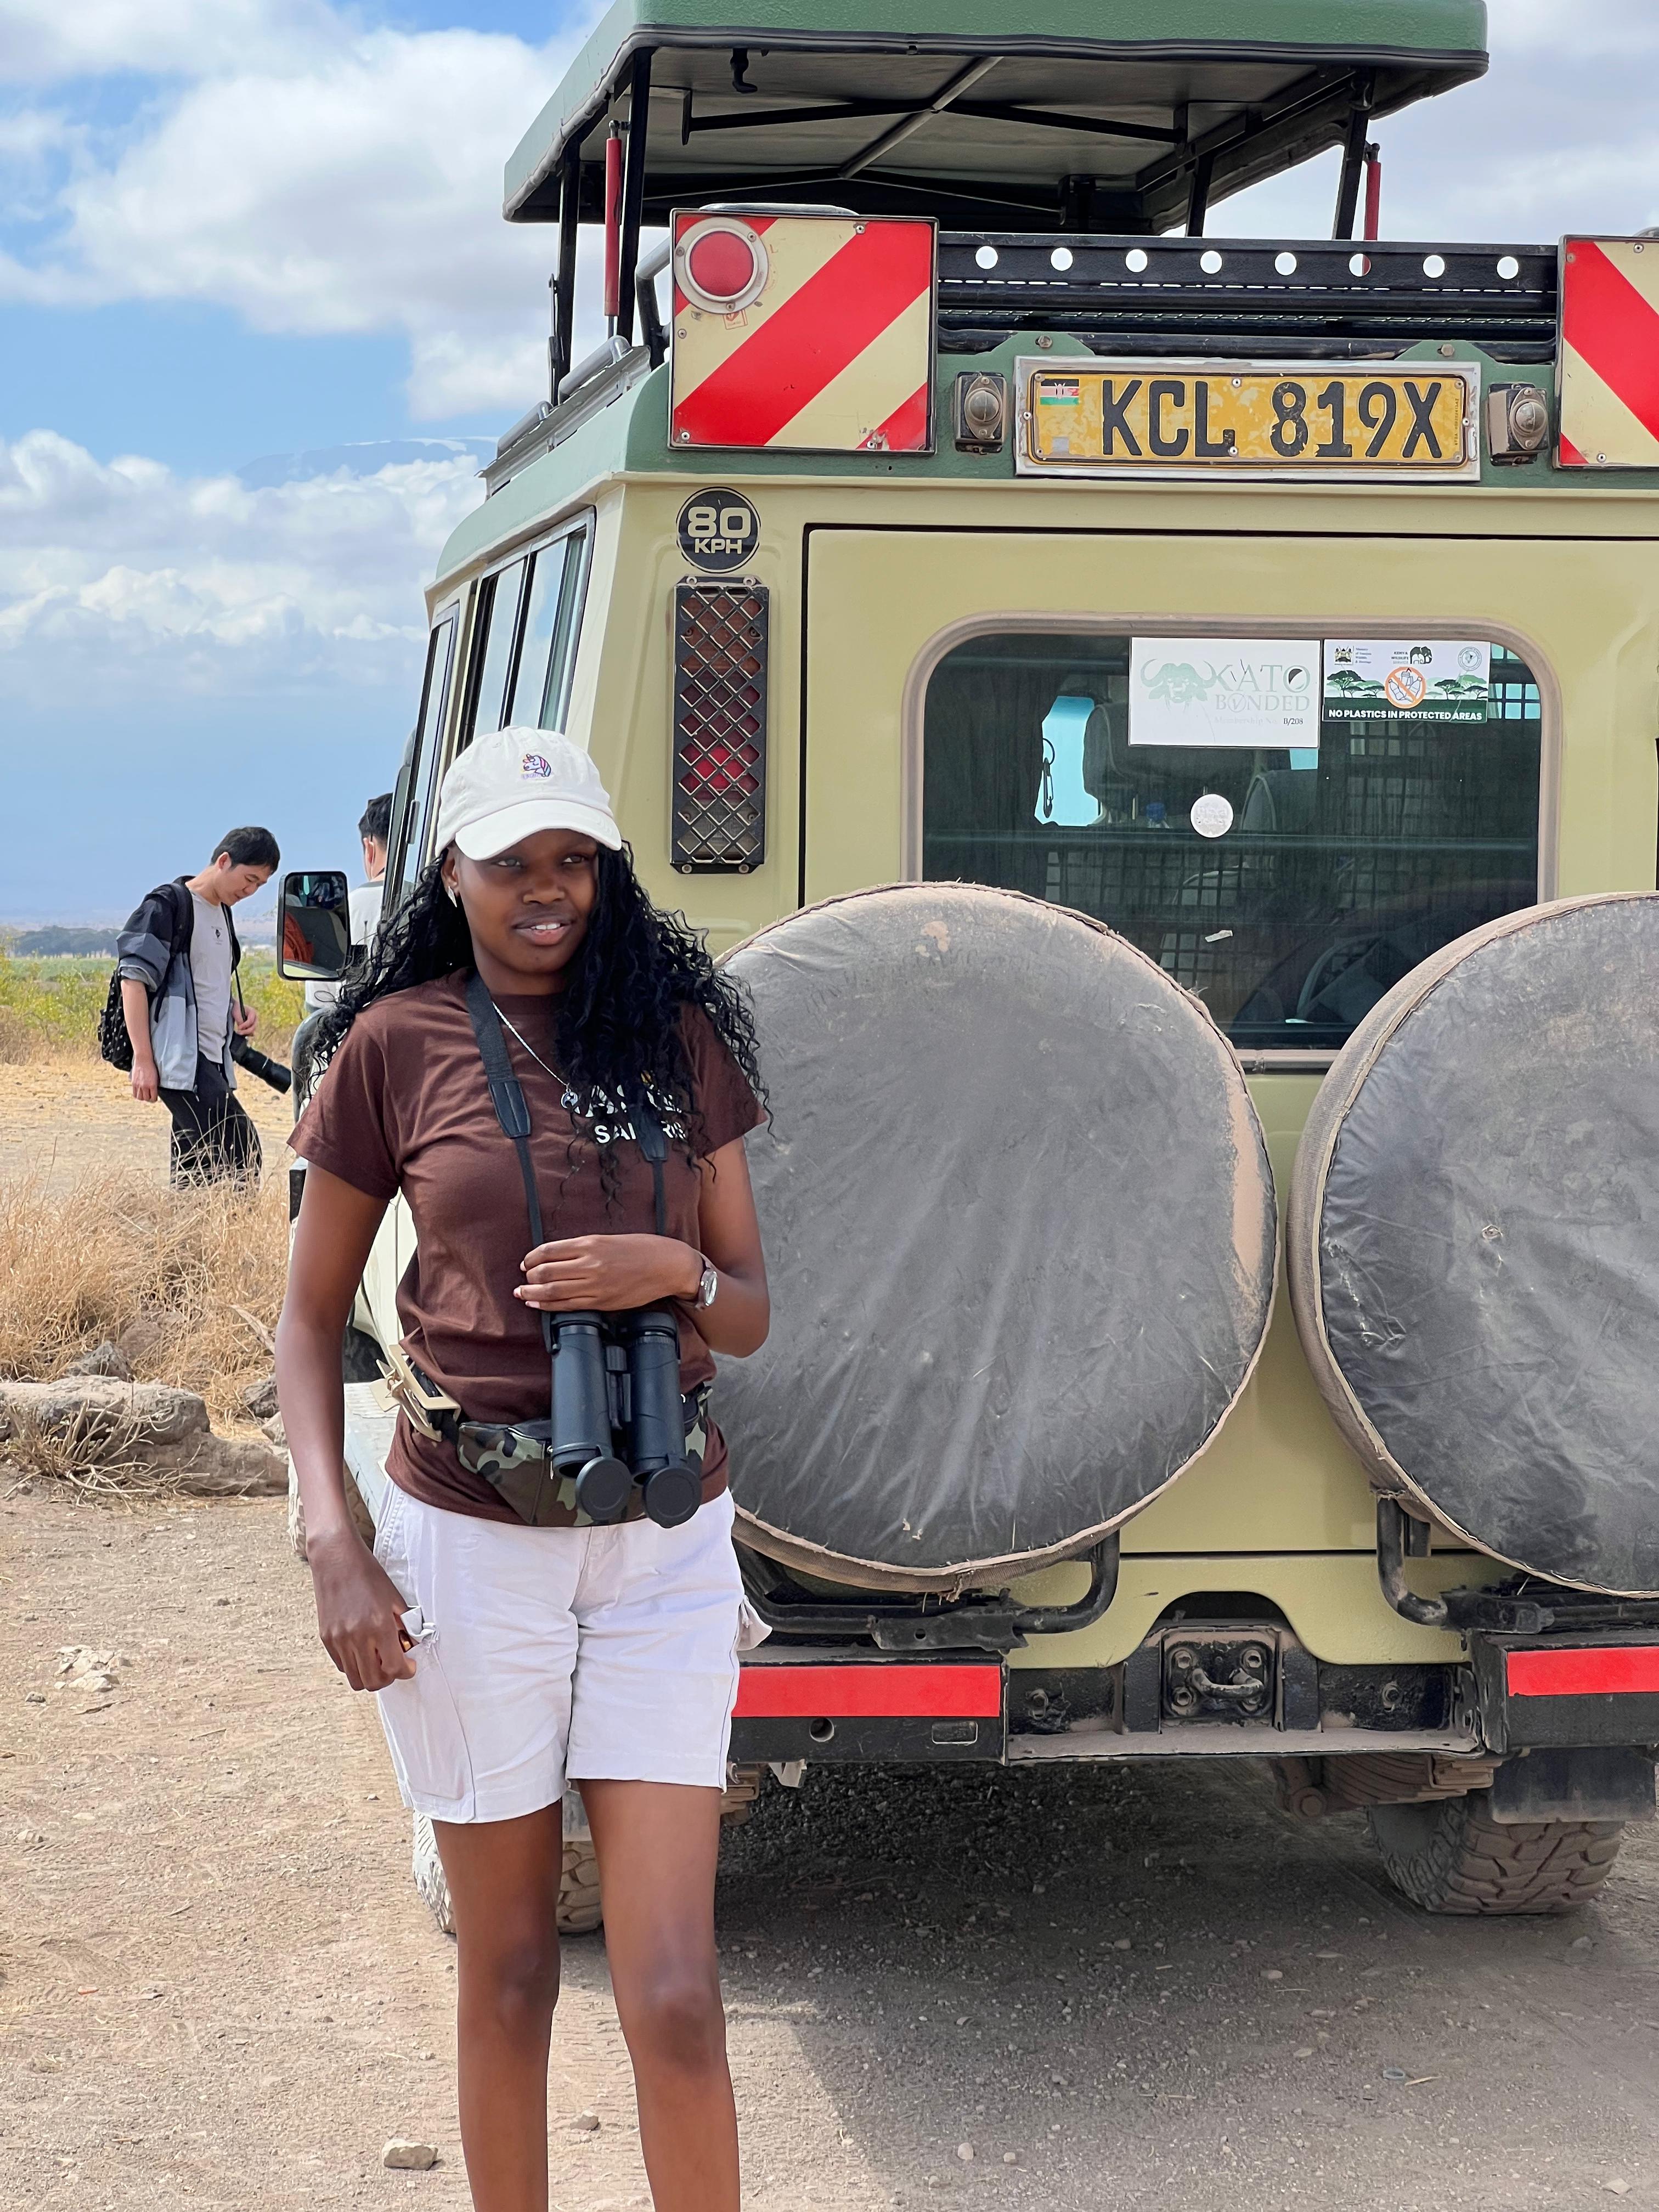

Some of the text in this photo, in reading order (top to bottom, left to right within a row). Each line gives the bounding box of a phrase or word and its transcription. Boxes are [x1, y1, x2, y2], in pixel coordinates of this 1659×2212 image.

[1102, 380, 1235, 458] KCL
[1270, 381, 1442, 459] 819X
[687, 506, 751, 538] 80
[695, 538, 742, 554] KPH
[1215, 664, 1311, 693] KATO
[1344, 710, 1386, 718] PLASTICS
[1399, 712, 1451, 720] PROTECTED
